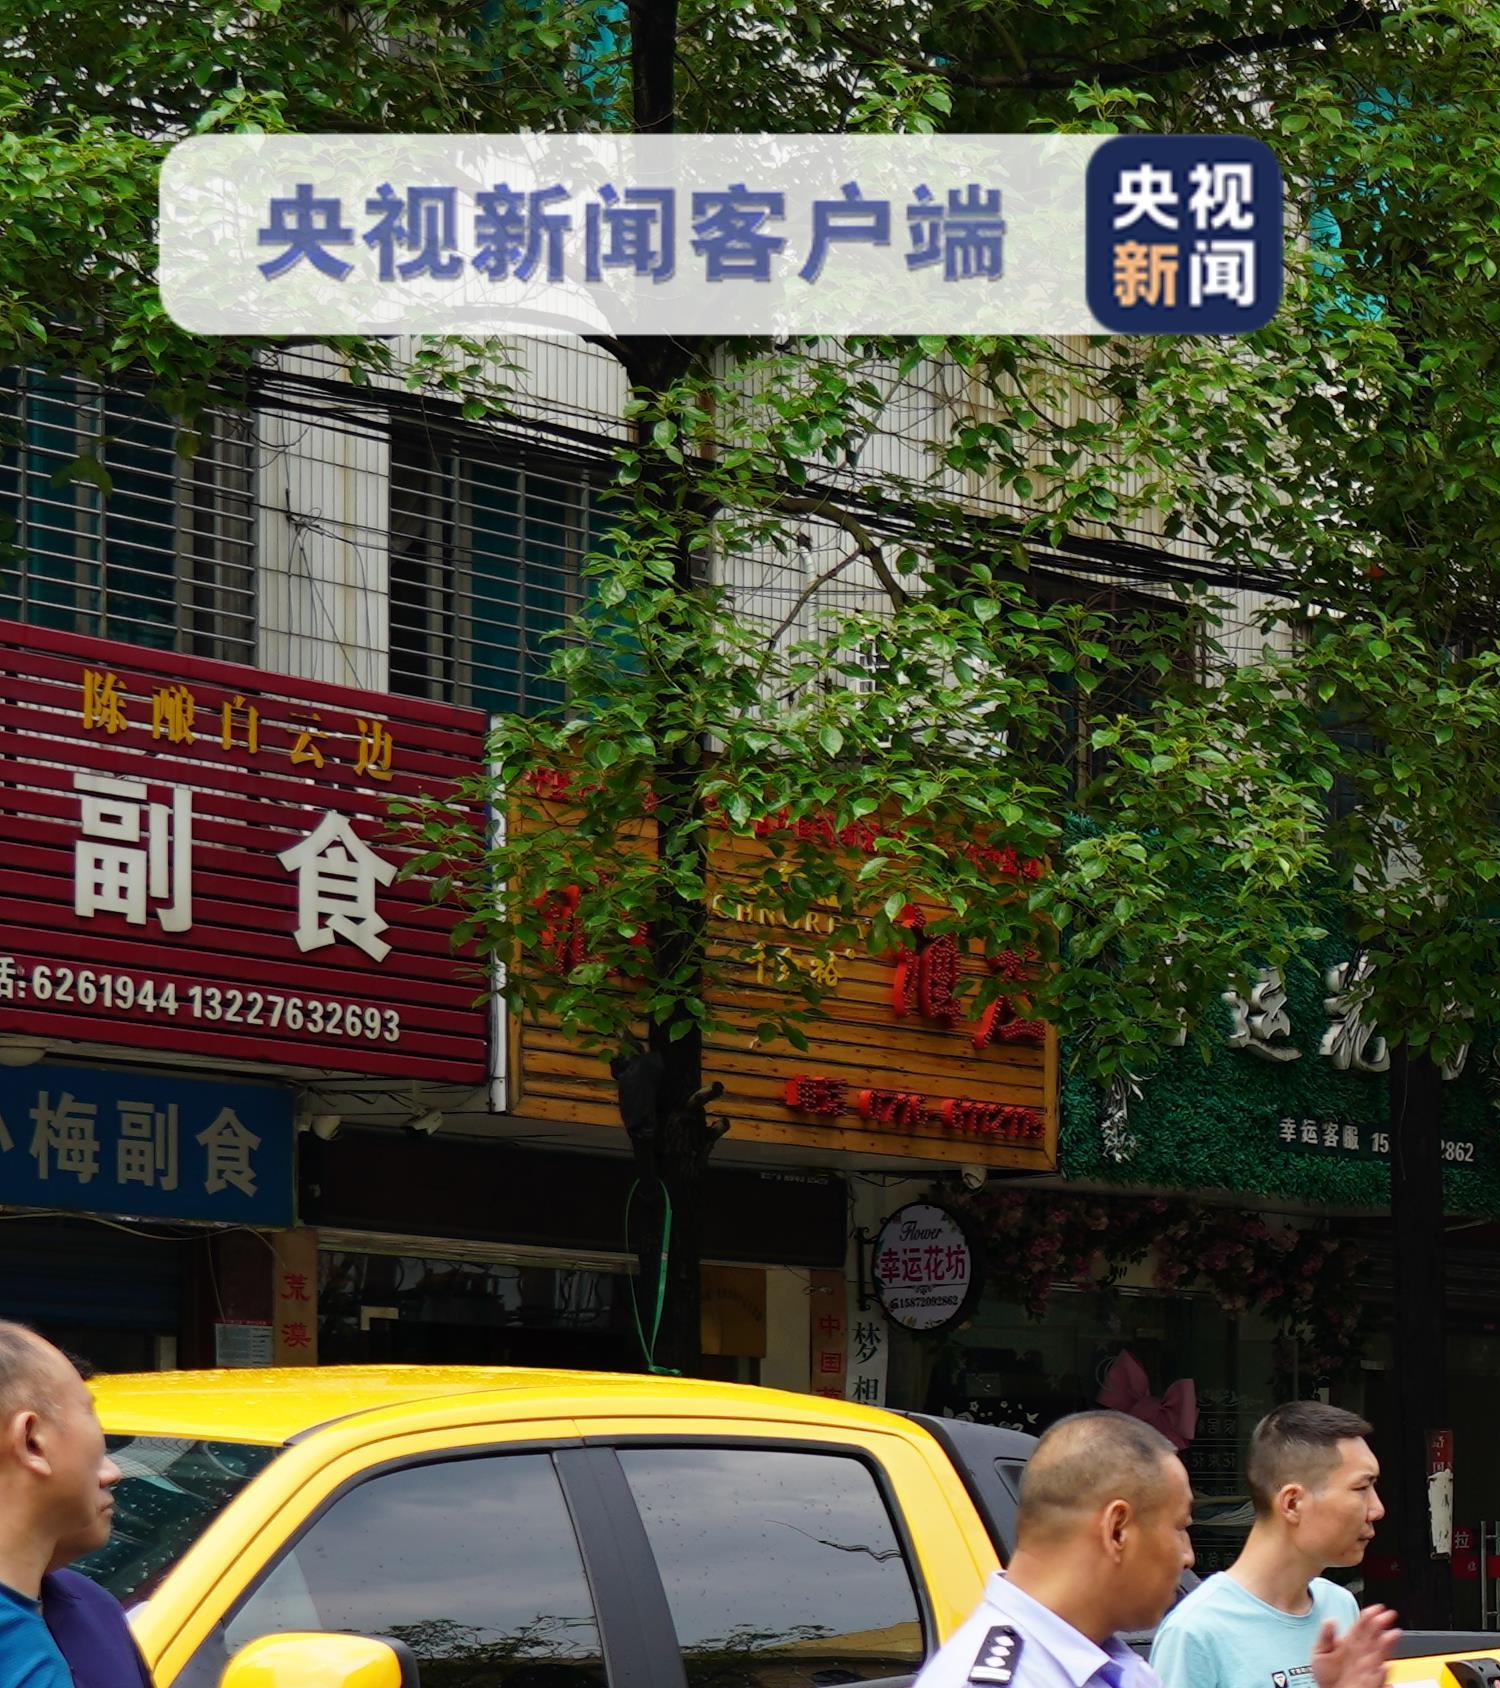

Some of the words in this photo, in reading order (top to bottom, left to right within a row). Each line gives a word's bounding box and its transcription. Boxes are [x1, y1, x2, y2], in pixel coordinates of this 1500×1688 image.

[83, 668, 395, 783] 陈酿白云边
[73, 772, 396, 963] 副食
[188, 984, 400, 1042] 13227632693
[0, 1090, 262, 1198] 梅副食
[1279, 1116, 1360, 1152] 幸运客服
[899, 1221, 943, 1242] Flower
[881, 1244, 966, 1282] 幸运花坊
